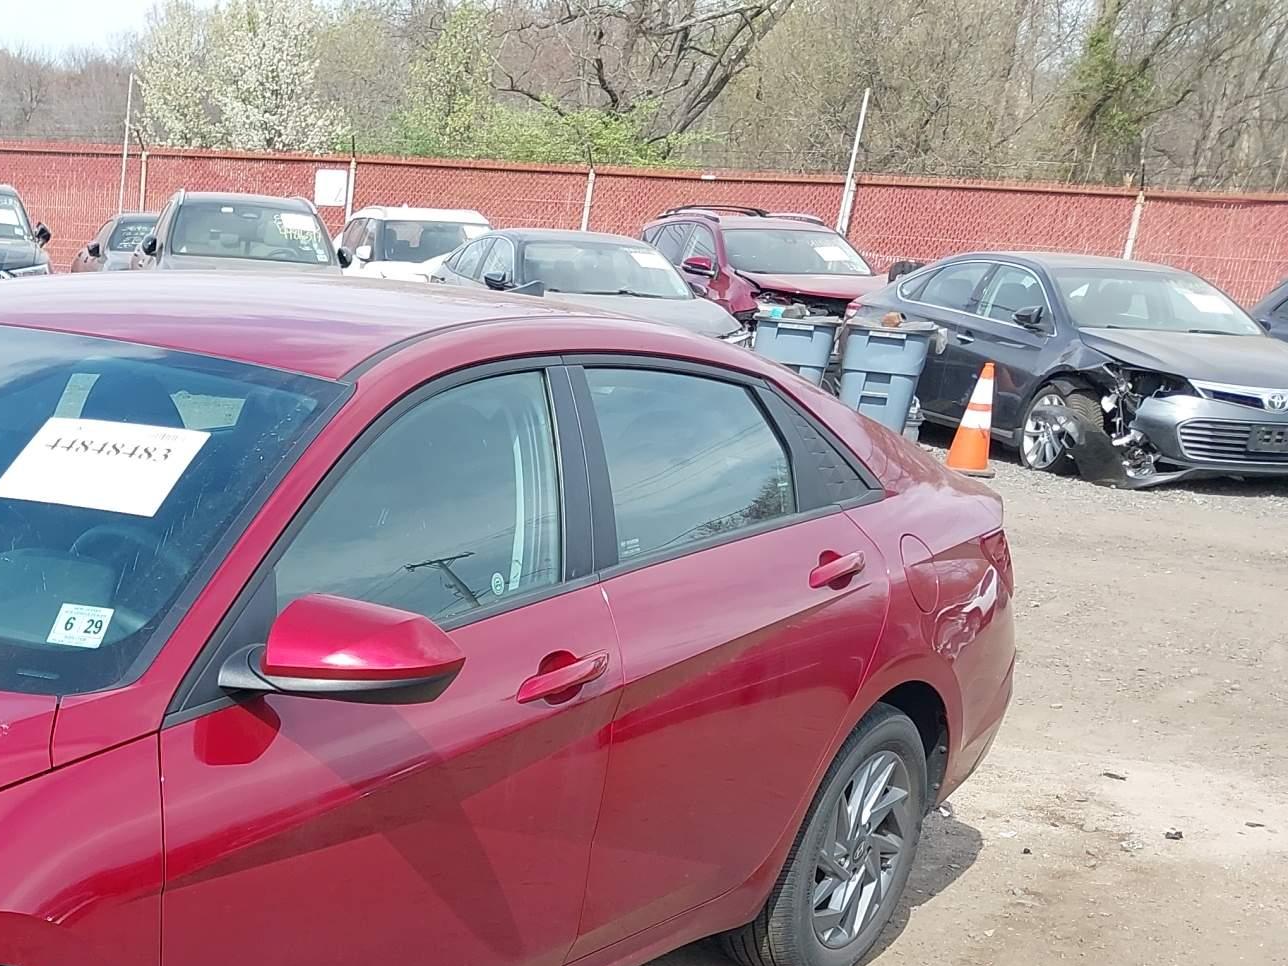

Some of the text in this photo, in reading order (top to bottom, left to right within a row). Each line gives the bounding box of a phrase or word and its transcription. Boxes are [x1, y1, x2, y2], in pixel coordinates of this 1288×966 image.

[45, 436, 173, 462] 44848483
[64, 616, 103, 635] 6 29
